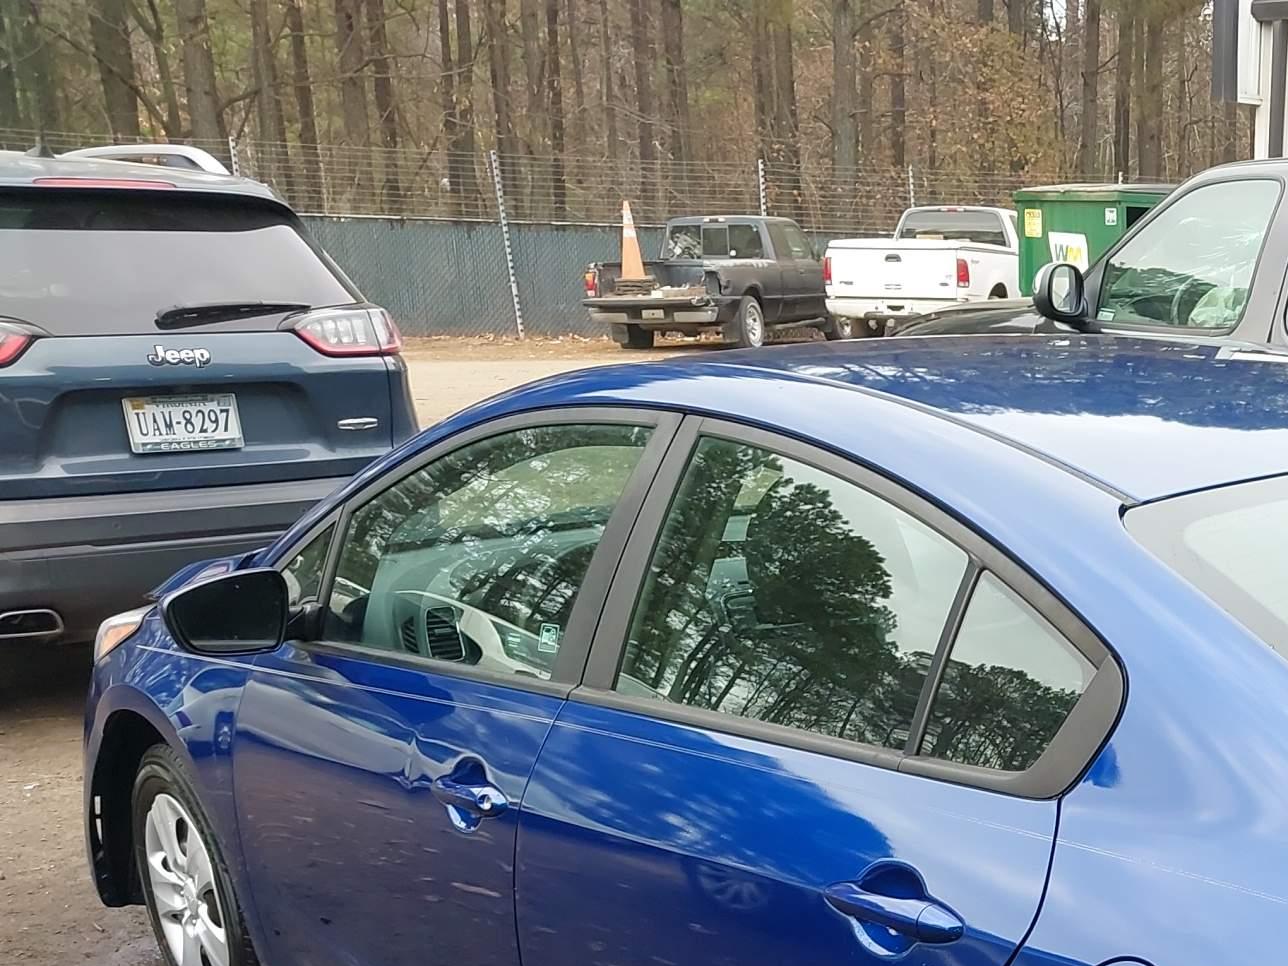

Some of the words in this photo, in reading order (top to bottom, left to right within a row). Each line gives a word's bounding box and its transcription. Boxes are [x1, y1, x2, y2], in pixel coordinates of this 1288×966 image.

[147, 345, 211, 368] Jeep
[134, 408, 230, 437] UAM-8297
[160, 440, 217, 450] EAGLES
